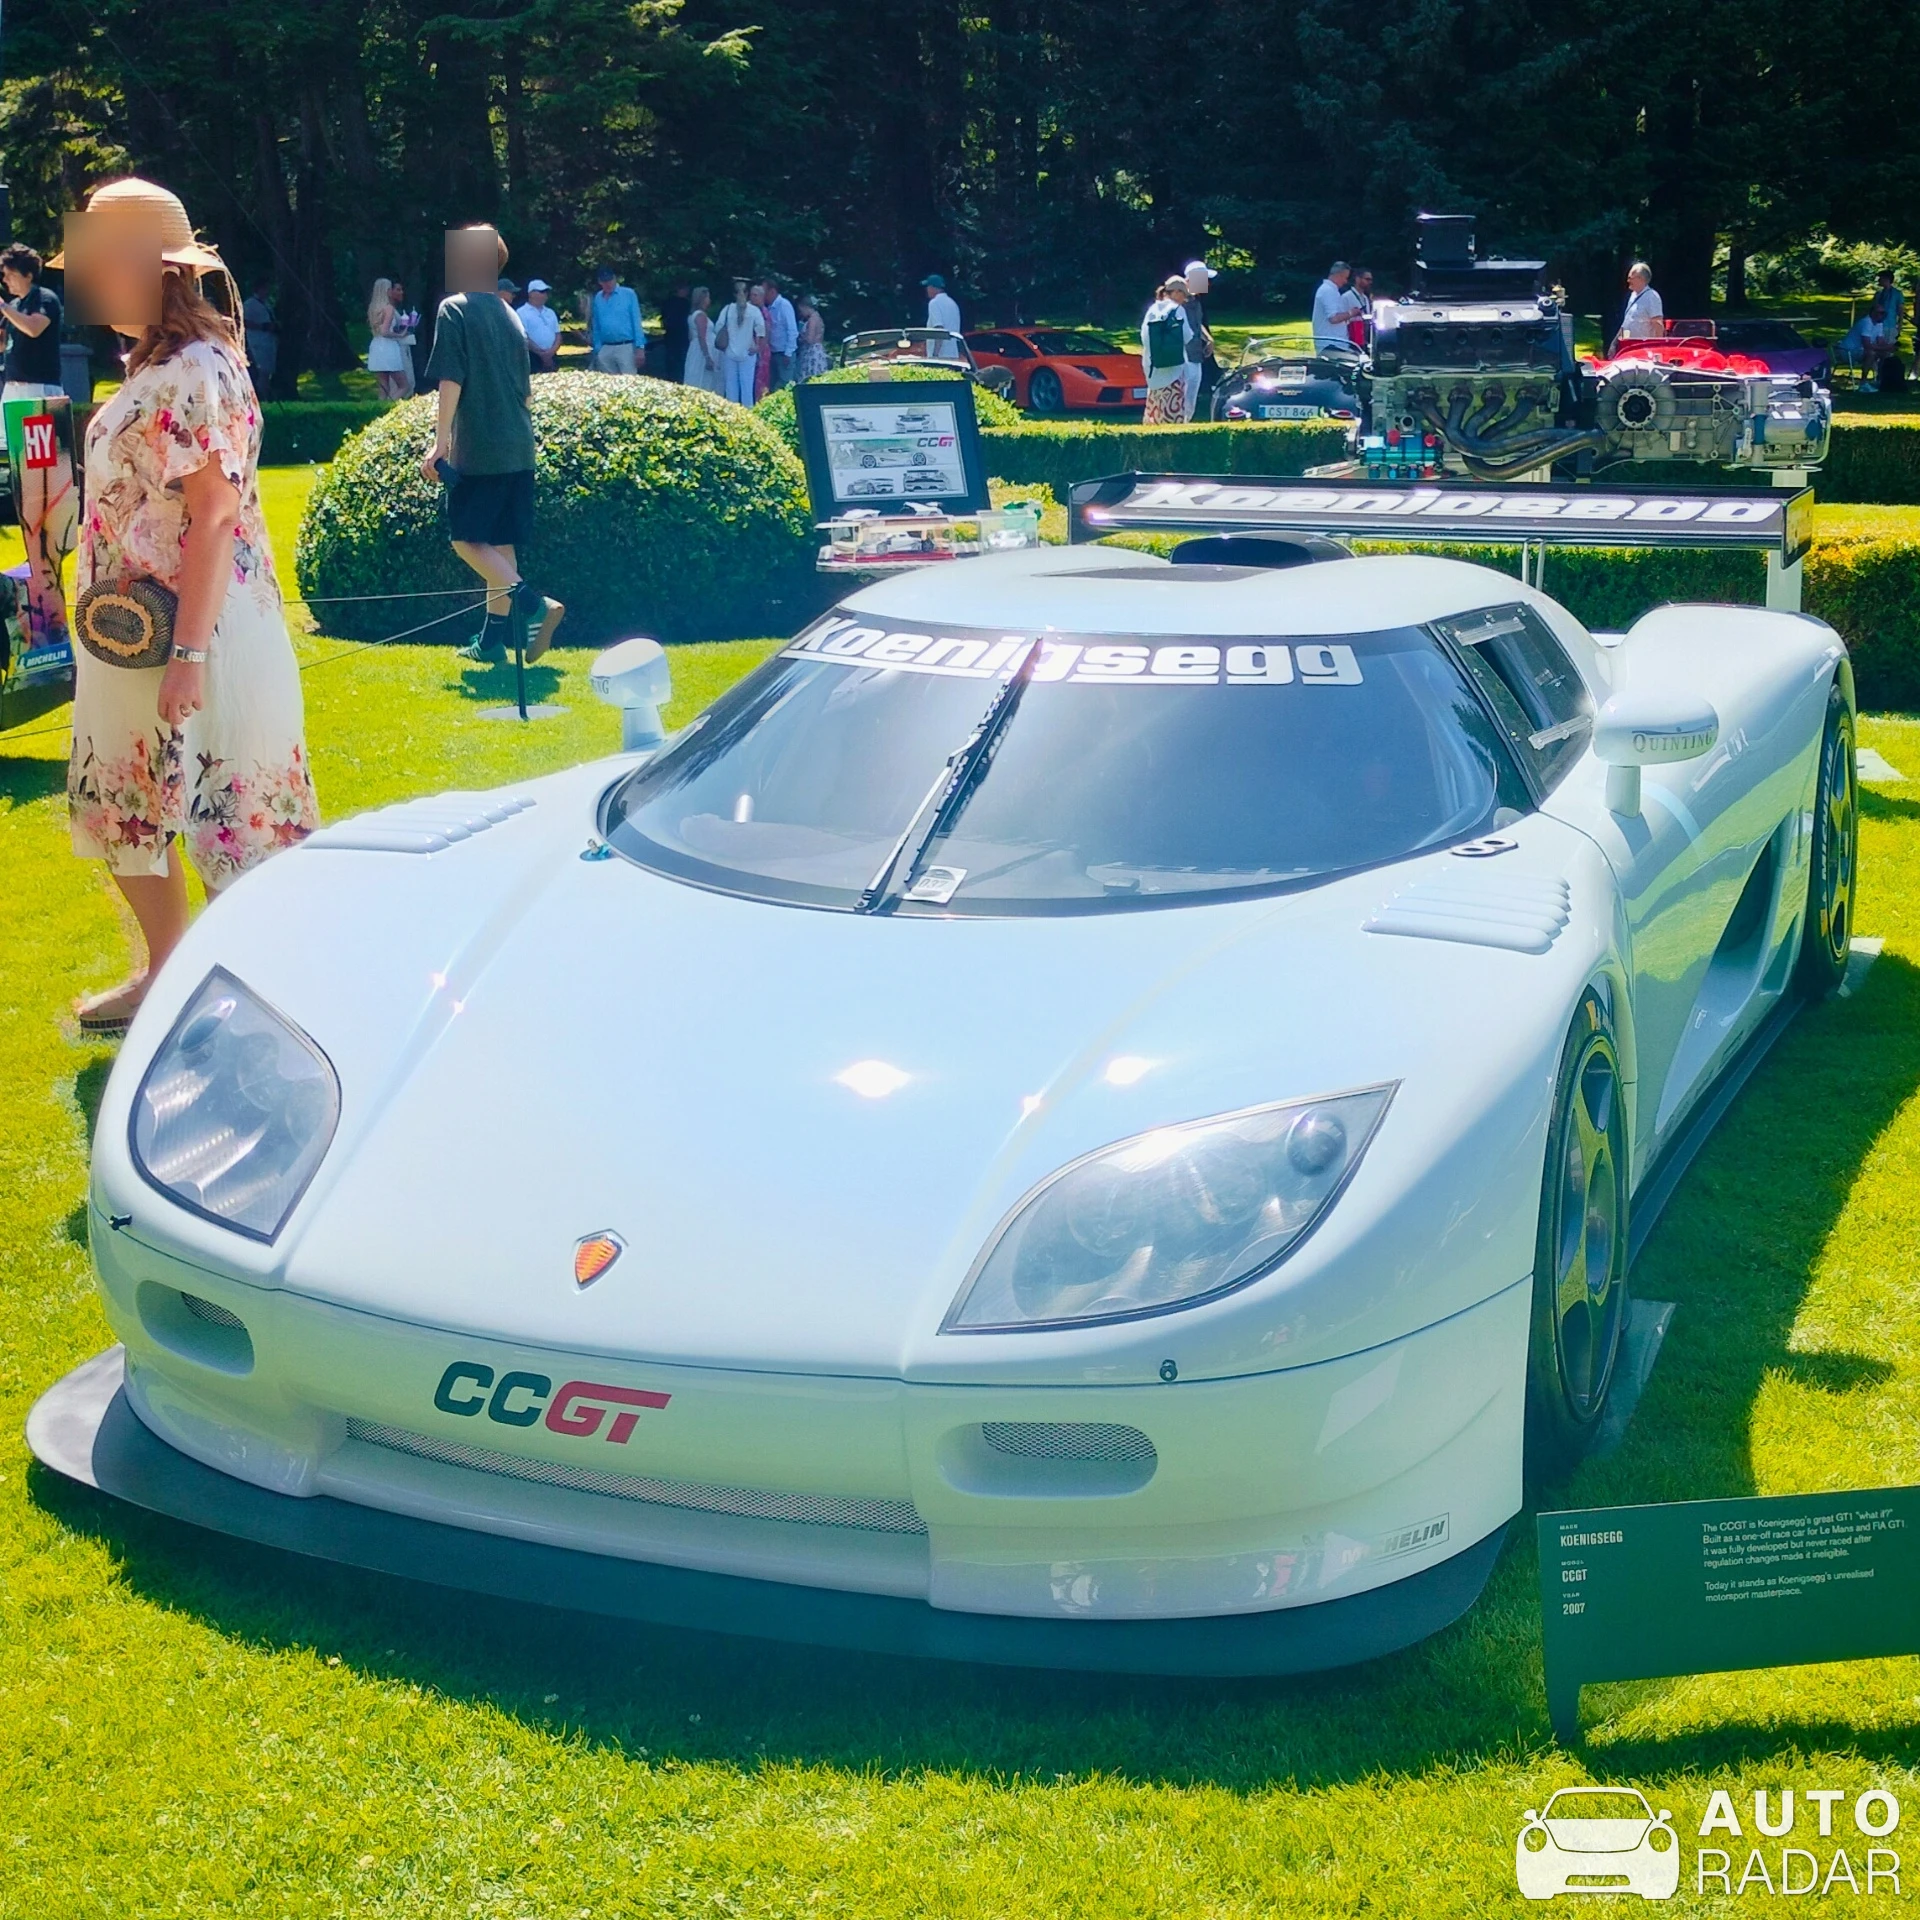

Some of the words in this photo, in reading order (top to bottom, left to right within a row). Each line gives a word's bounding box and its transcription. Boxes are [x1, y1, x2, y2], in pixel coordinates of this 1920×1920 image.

[1268, 407, 1290, 417] CST
[1292, 407, 1314, 417] 846
[24, 424, 53, 460] HY
[916, 436, 955, 448] CCGT
[1124, 482, 1780, 523] Koenigsegg
[26, 650, 68, 668] MICHELIN
[779, 615, 1364, 687] Koenigsegg
[1821, 742, 1834, 881] MICHELIN
[918, 878, 949, 889] 037
[433, 1360, 673, 1445] CCGT
[1702, 1523, 1718, 1533] The
[1719, 1520, 1748, 1531] CCGT
[1749, 1521, 1756, 1529] is
[1757, 1516, 1812, 1528] Koenigsegg's
[1813, 1515, 1834, 1526] great
[1835, 1512, 1853, 1522] GT1
[1855, 1511, 1878, 1520] "what
[1702, 1534, 1721, 1544] Built
[1741, 1531, 1771, 1540] one-off
[1772, 1531, 1790, 1539] race
[1792, 1529, 1805, 1537] car
[1807, 1527, 1818, 1535] for
[1819, 1526, 1830, 1535] Le
[1832, 1524, 1854, 1534] Mans
[1855, 1523, 1871, 1532] and
[1872, 1521, 1887, 1530] FIA
[1341, 1520, 1446, 1566] MHELIN
[1560, 1530, 1624, 1547] KOENIGSEGG
[1703, 1547, 1709, 1556] it
[1710, 1547, 1727, 1555] was
[1729, 1544, 1745, 1555] fully
[1746, 1541, 1789, 1552] developed
[1790, 1540, 1804, 1549] but
[1805, 1539, 1827, 1548] never
[1829, 1536, 1852, 1546] raced
[1853, 1535, 1872, 1544] after
[1703, 1557, 1744, 1569] regulation
[1745, 1554, 1780, 1565] changes
[1781, 1551, 1804, 1561] made
[1805, 1551, 1811, 1559] it
[1812, 1548, 1850, 1560] ineligible.
[1562, 1569, 1588, 1582] CCGT
[1704, 1581, 1729, 1591] Today
[1730, 1579, 1736, 1589] it
[1737, 1578, 1765, 1588] stands
[1766, 1578, 1777, 1586] as
[1778, 1573, 1832, 1585] Koenigsegg's
[1833, 1569, 1875, 1581] unrealised
[1705, 1591, 1750, 1602] motorsport
[1751, 1587, 1803, 1599] masterpiece.
[1562, 1602, 1586, 1615] 2007
